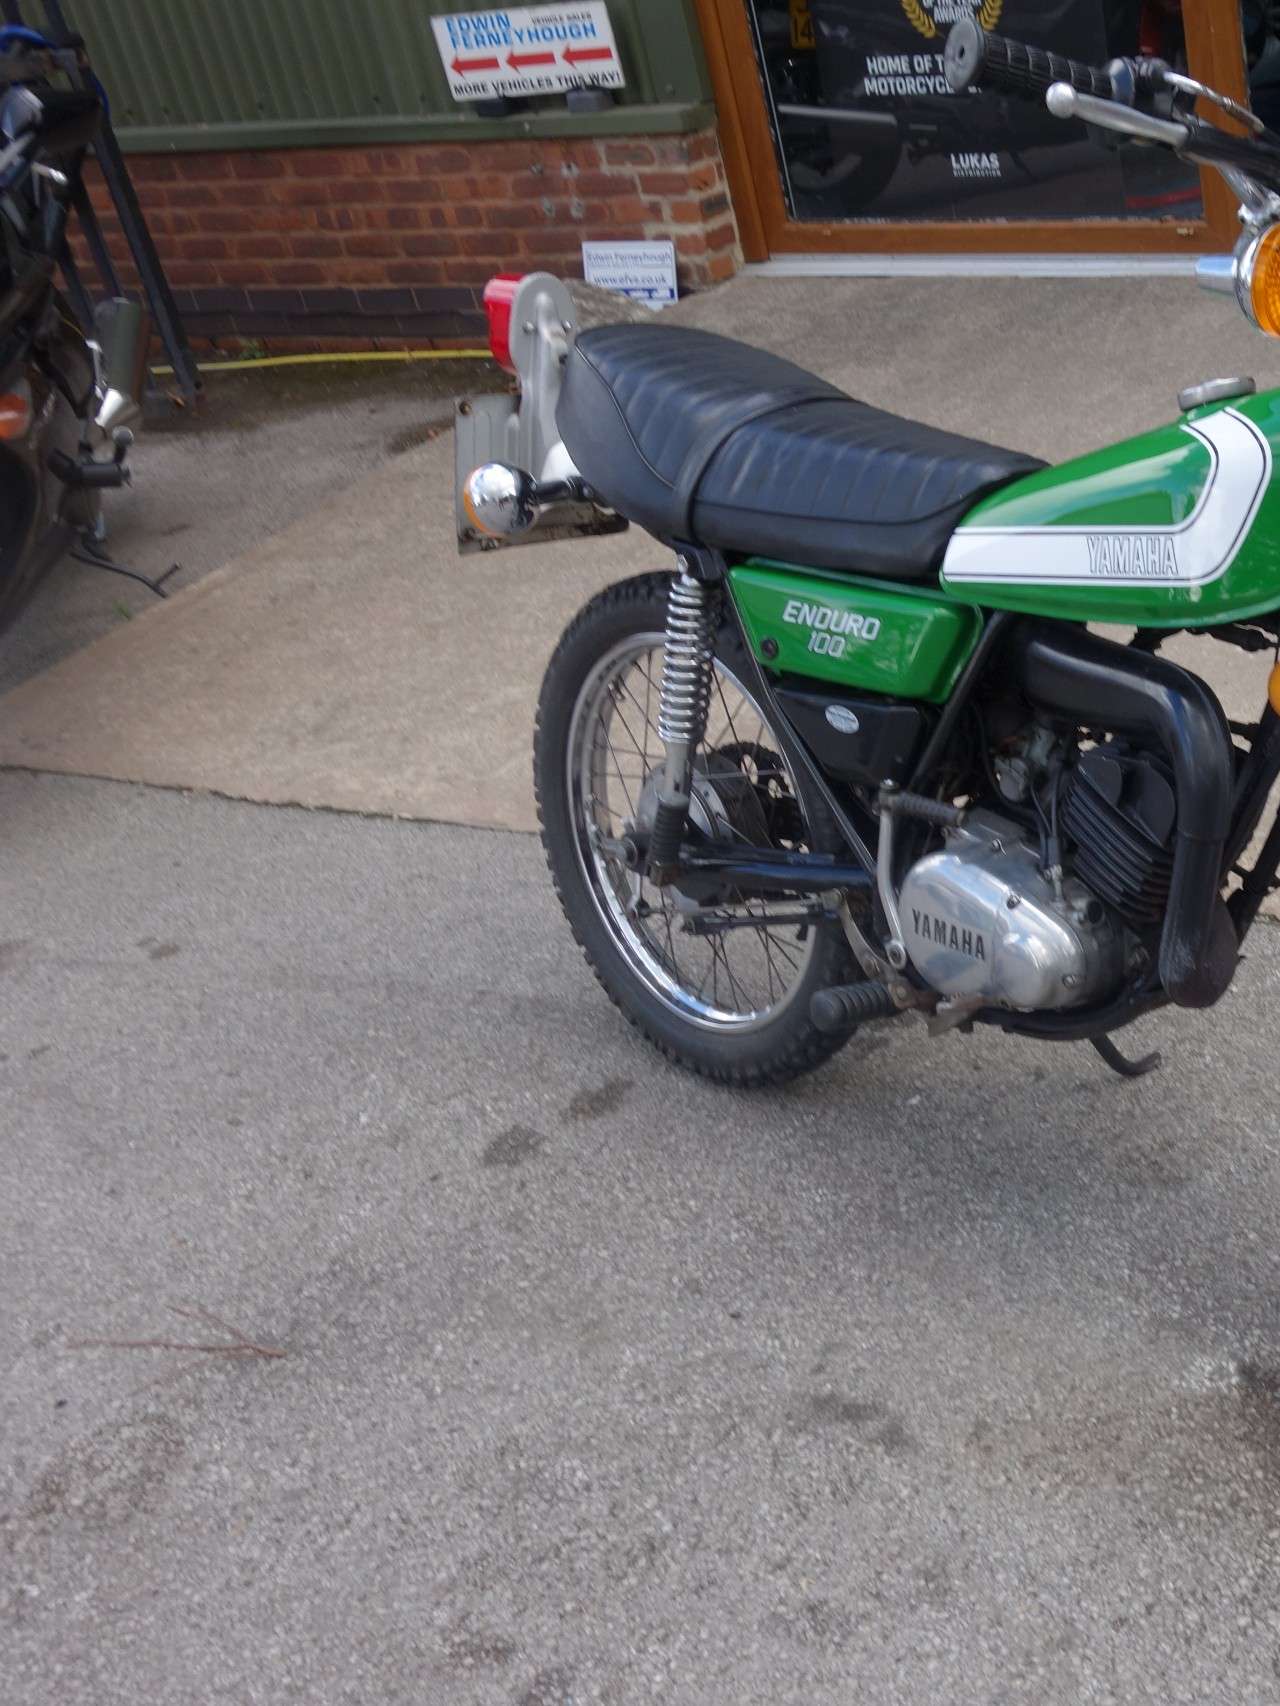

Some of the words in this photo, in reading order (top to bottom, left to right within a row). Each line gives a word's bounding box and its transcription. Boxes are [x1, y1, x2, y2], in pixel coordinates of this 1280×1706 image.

[446, 11, 511, 33] EDWIN
[451, 22, 597, 49] FERNEYHOUGH
[866, 56, 911, 75] HOME
[913, 54, 933, 74] OF
[453, 82, 488, 96] MORE
[492, 75, 552, 94] VEHICLES
[556, 72, 587, 89] THIS
[589, 71, 620, 86] WAY!
[864, 75, 982, 96] MOTORCYCL
[951, 153, 999, 169] LUKAS
[1085, 535, 1179, 576] YAMAHA
[783, 600, 881, 640] ENDURO
[808, 631, 846, 657] 100
[912, 908, 985, 960] YAMAHA
